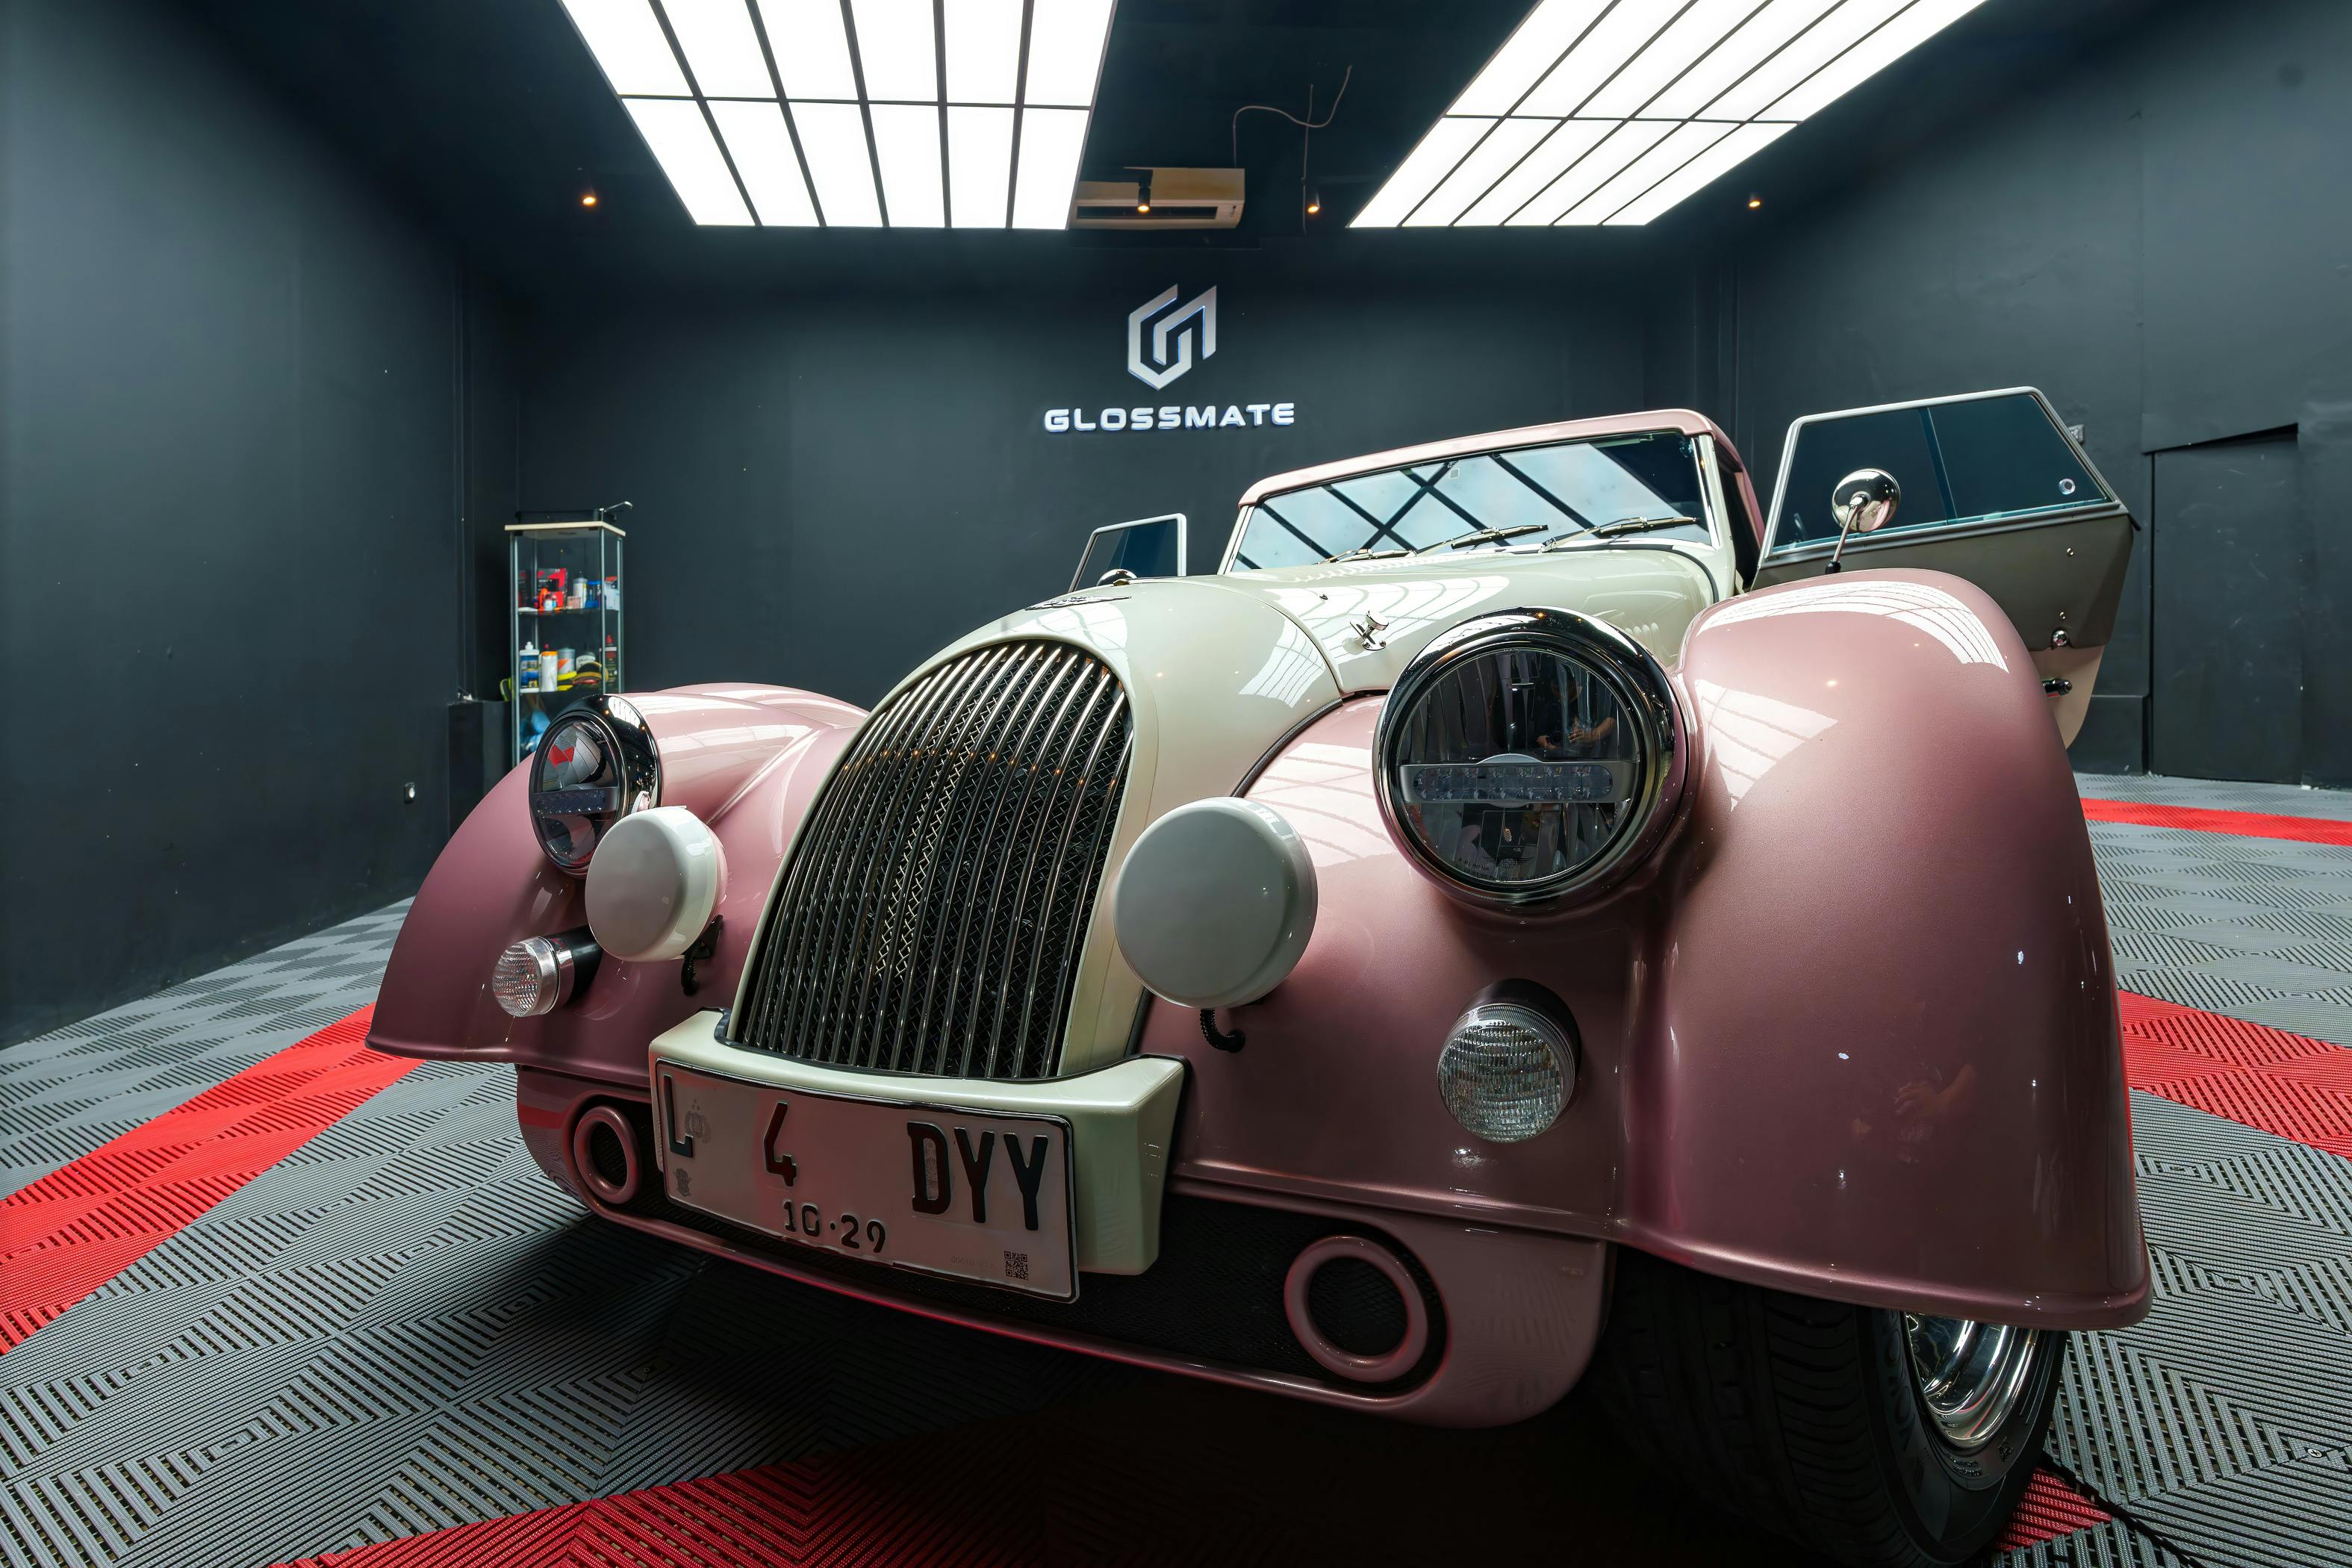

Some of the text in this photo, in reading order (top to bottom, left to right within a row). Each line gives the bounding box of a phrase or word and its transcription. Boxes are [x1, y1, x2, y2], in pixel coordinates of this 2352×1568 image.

[1044, 402, 1295, 432] GLOSSMATE
[663, 1074, 694, 1158] L
[762, 1101, 797, 1187] 4
[906, 1121, 1049, 1231] DYY
